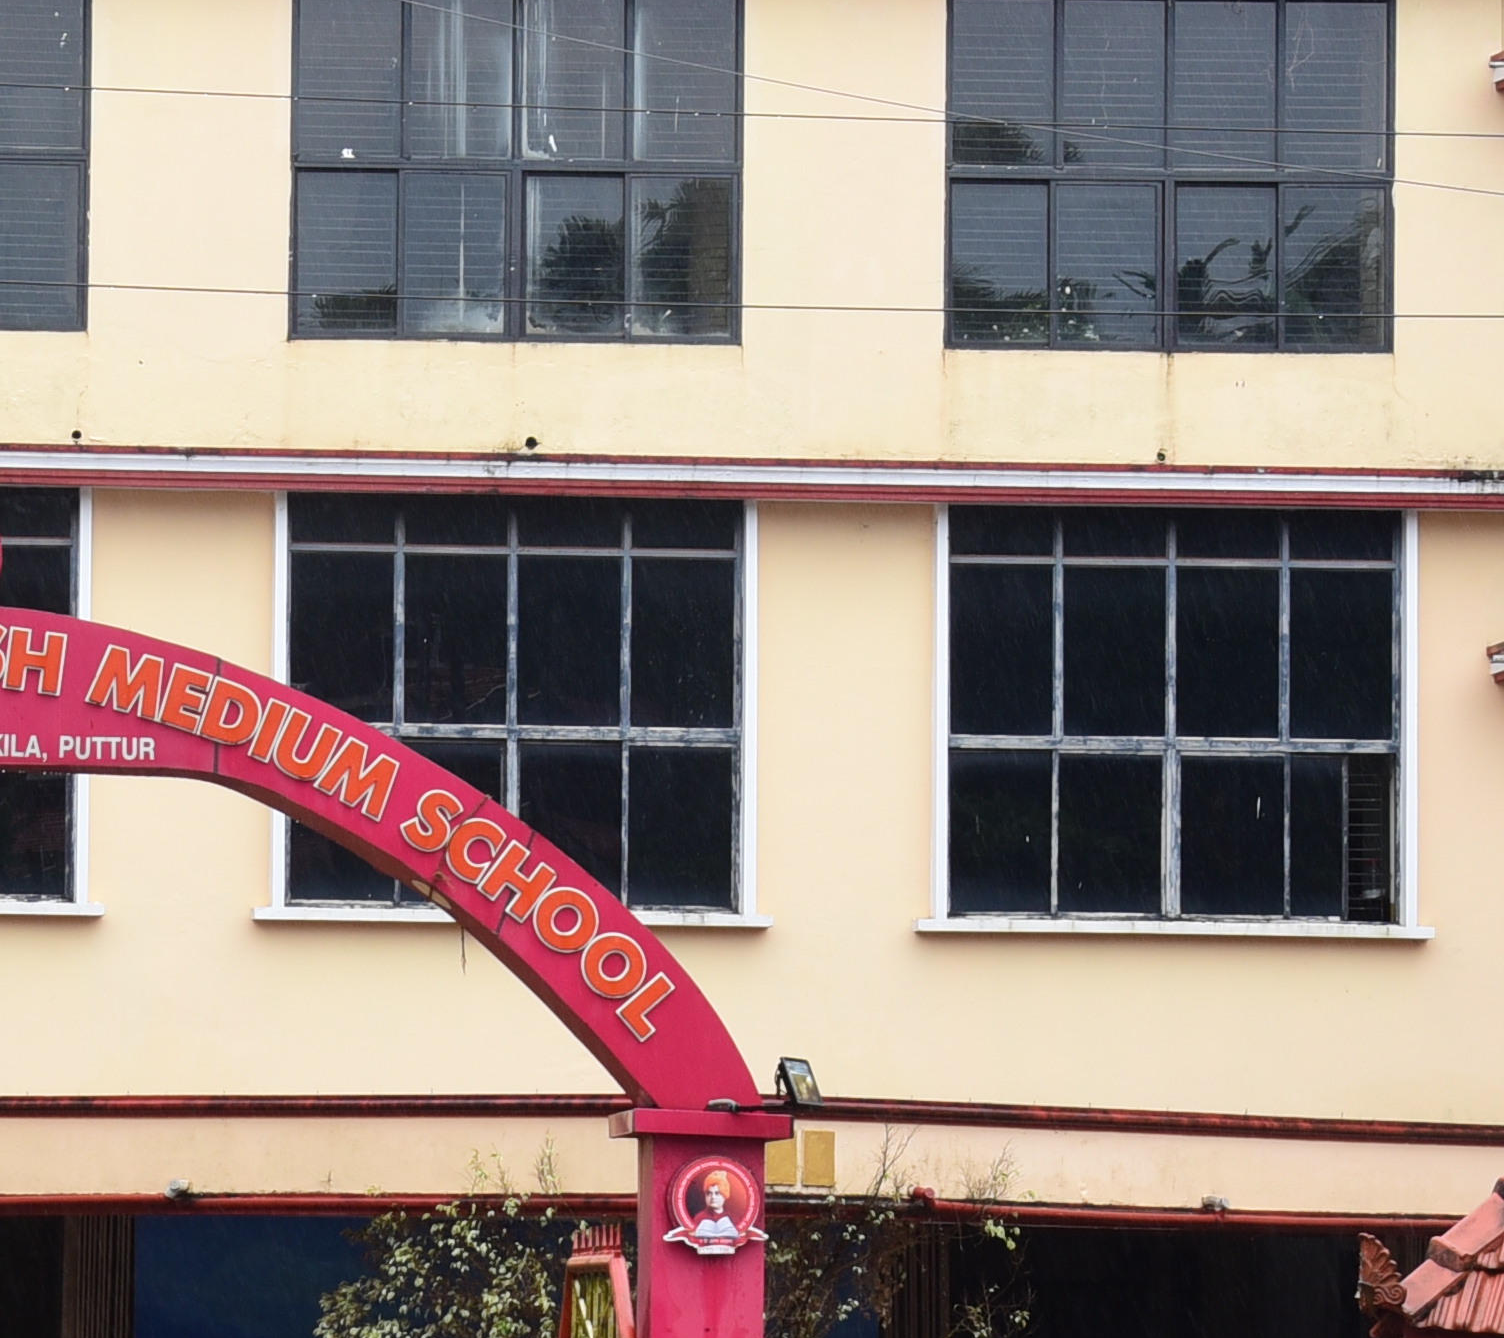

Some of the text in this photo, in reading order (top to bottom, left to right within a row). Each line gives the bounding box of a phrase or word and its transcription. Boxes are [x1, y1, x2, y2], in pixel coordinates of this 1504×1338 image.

[58, 735, 156, 761] PUTTUR
[86, 644, 400, 823] MEDIUM
[400, 789, 675, 1043] SCHOOL
